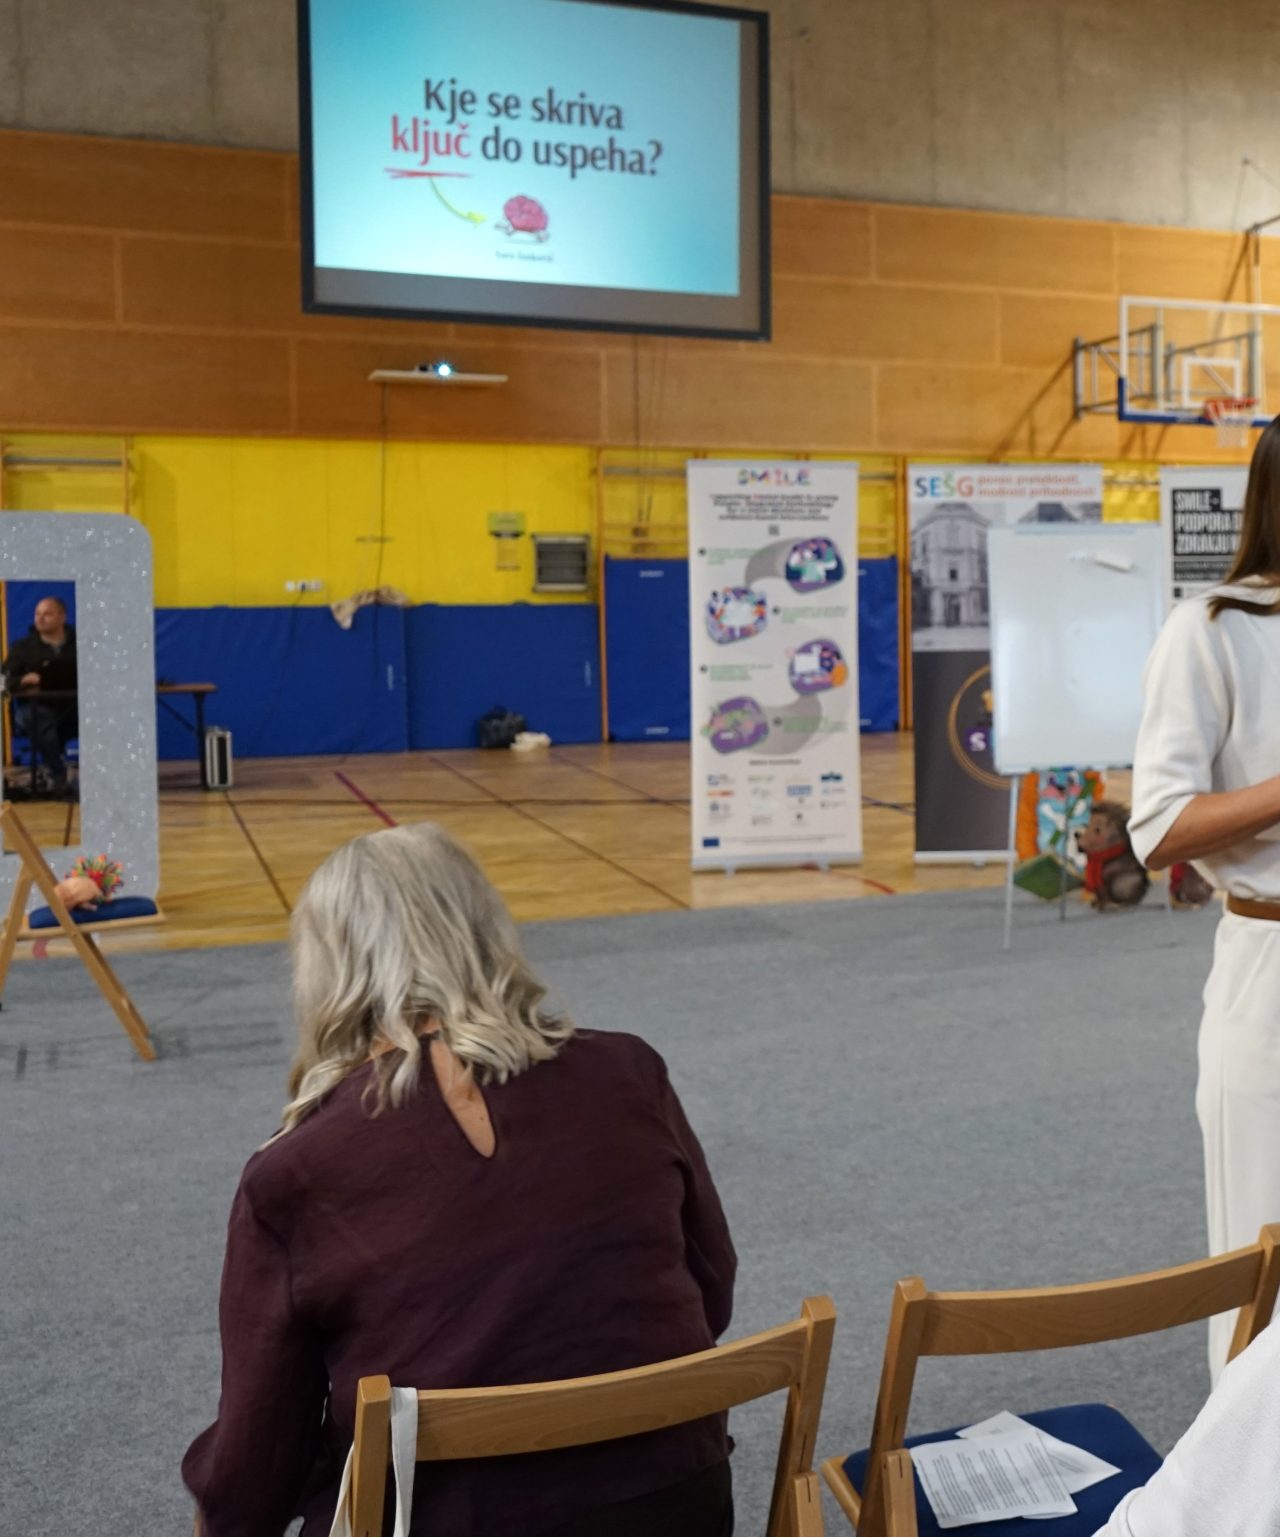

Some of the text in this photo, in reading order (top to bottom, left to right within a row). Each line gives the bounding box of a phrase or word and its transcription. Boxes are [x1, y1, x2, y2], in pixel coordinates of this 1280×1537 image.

[424, 78, 623, 130] Kje se skriva
[391, 113, 663, 180] ključ do uspeha?
[738, 469, 811, 486] SMILE
[915, 470, 974, 498] SEŠG
[1175, 512, 1230, 533] PODPORA
